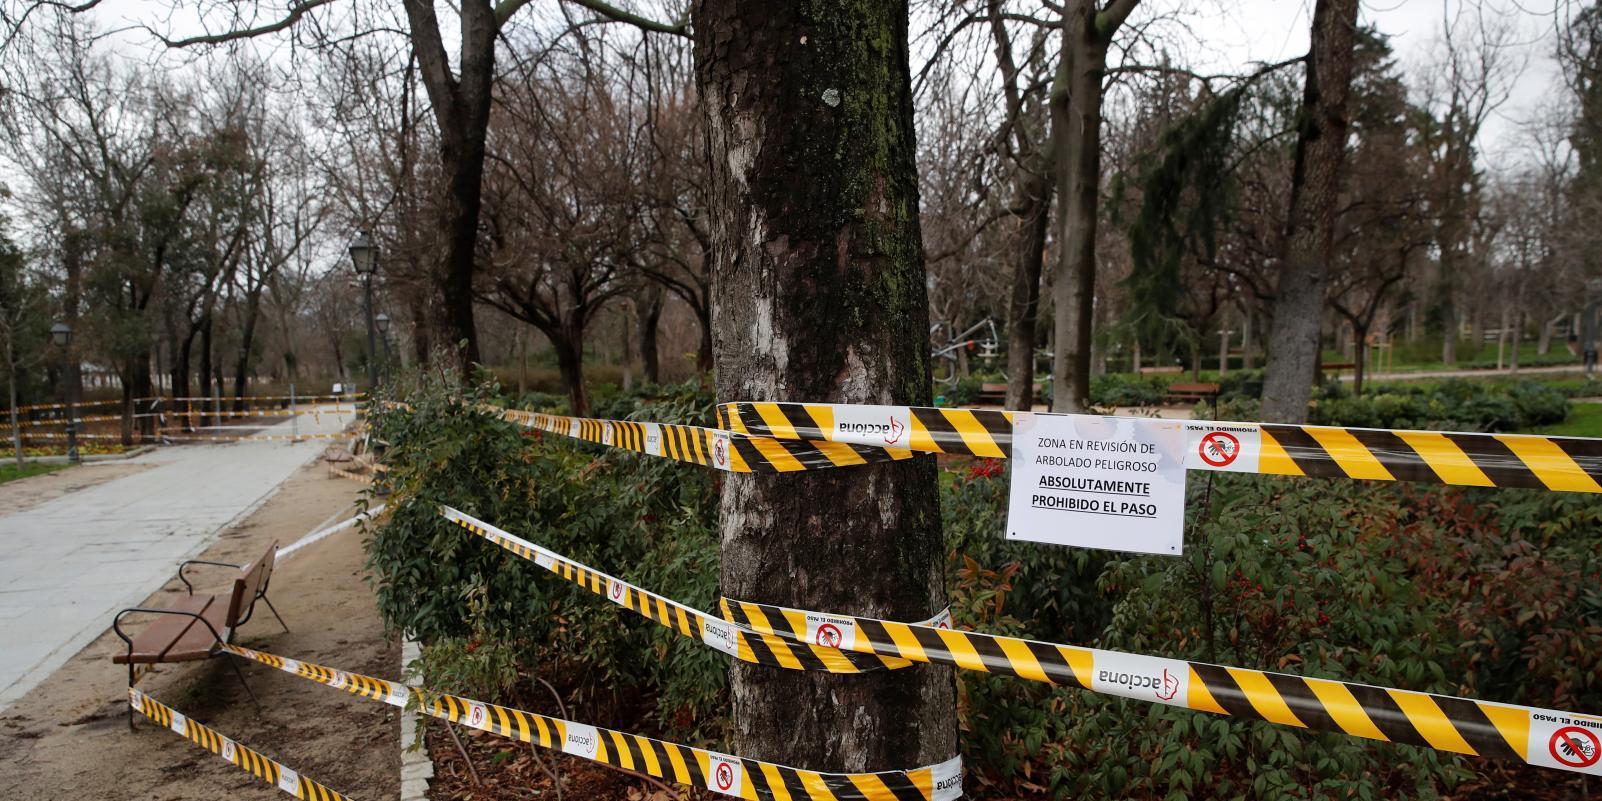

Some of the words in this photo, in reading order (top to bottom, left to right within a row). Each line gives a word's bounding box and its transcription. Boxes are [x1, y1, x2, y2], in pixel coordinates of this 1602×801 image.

[840, 422, 890, 437] acciona
[1038, 437, 1067, 449] ZONA
[1069, 439, 1084, 450] EN
[1086, 440, 1137, 453] REVISIÓN
[1140, 443, 1156, 454] DE
[1035, 455, 1092, 468] ARBOLADO
[1095, 459, 1157, 473] PELIGROSO
[1039, 475, 1150, 494] ABSOLUTAMENTE
[1032, 494, 1100, 511] PROHIBIDO
[1103, 501, 1117, 512] EL
[1120, 502, 1157, 516] PASO
[705, 623, 728, 640] acciona
[1099, 670, 1162, 690] acciona
[1533, 713, 1557, 723] PASO
[568, 733, 590, 747] acciona
